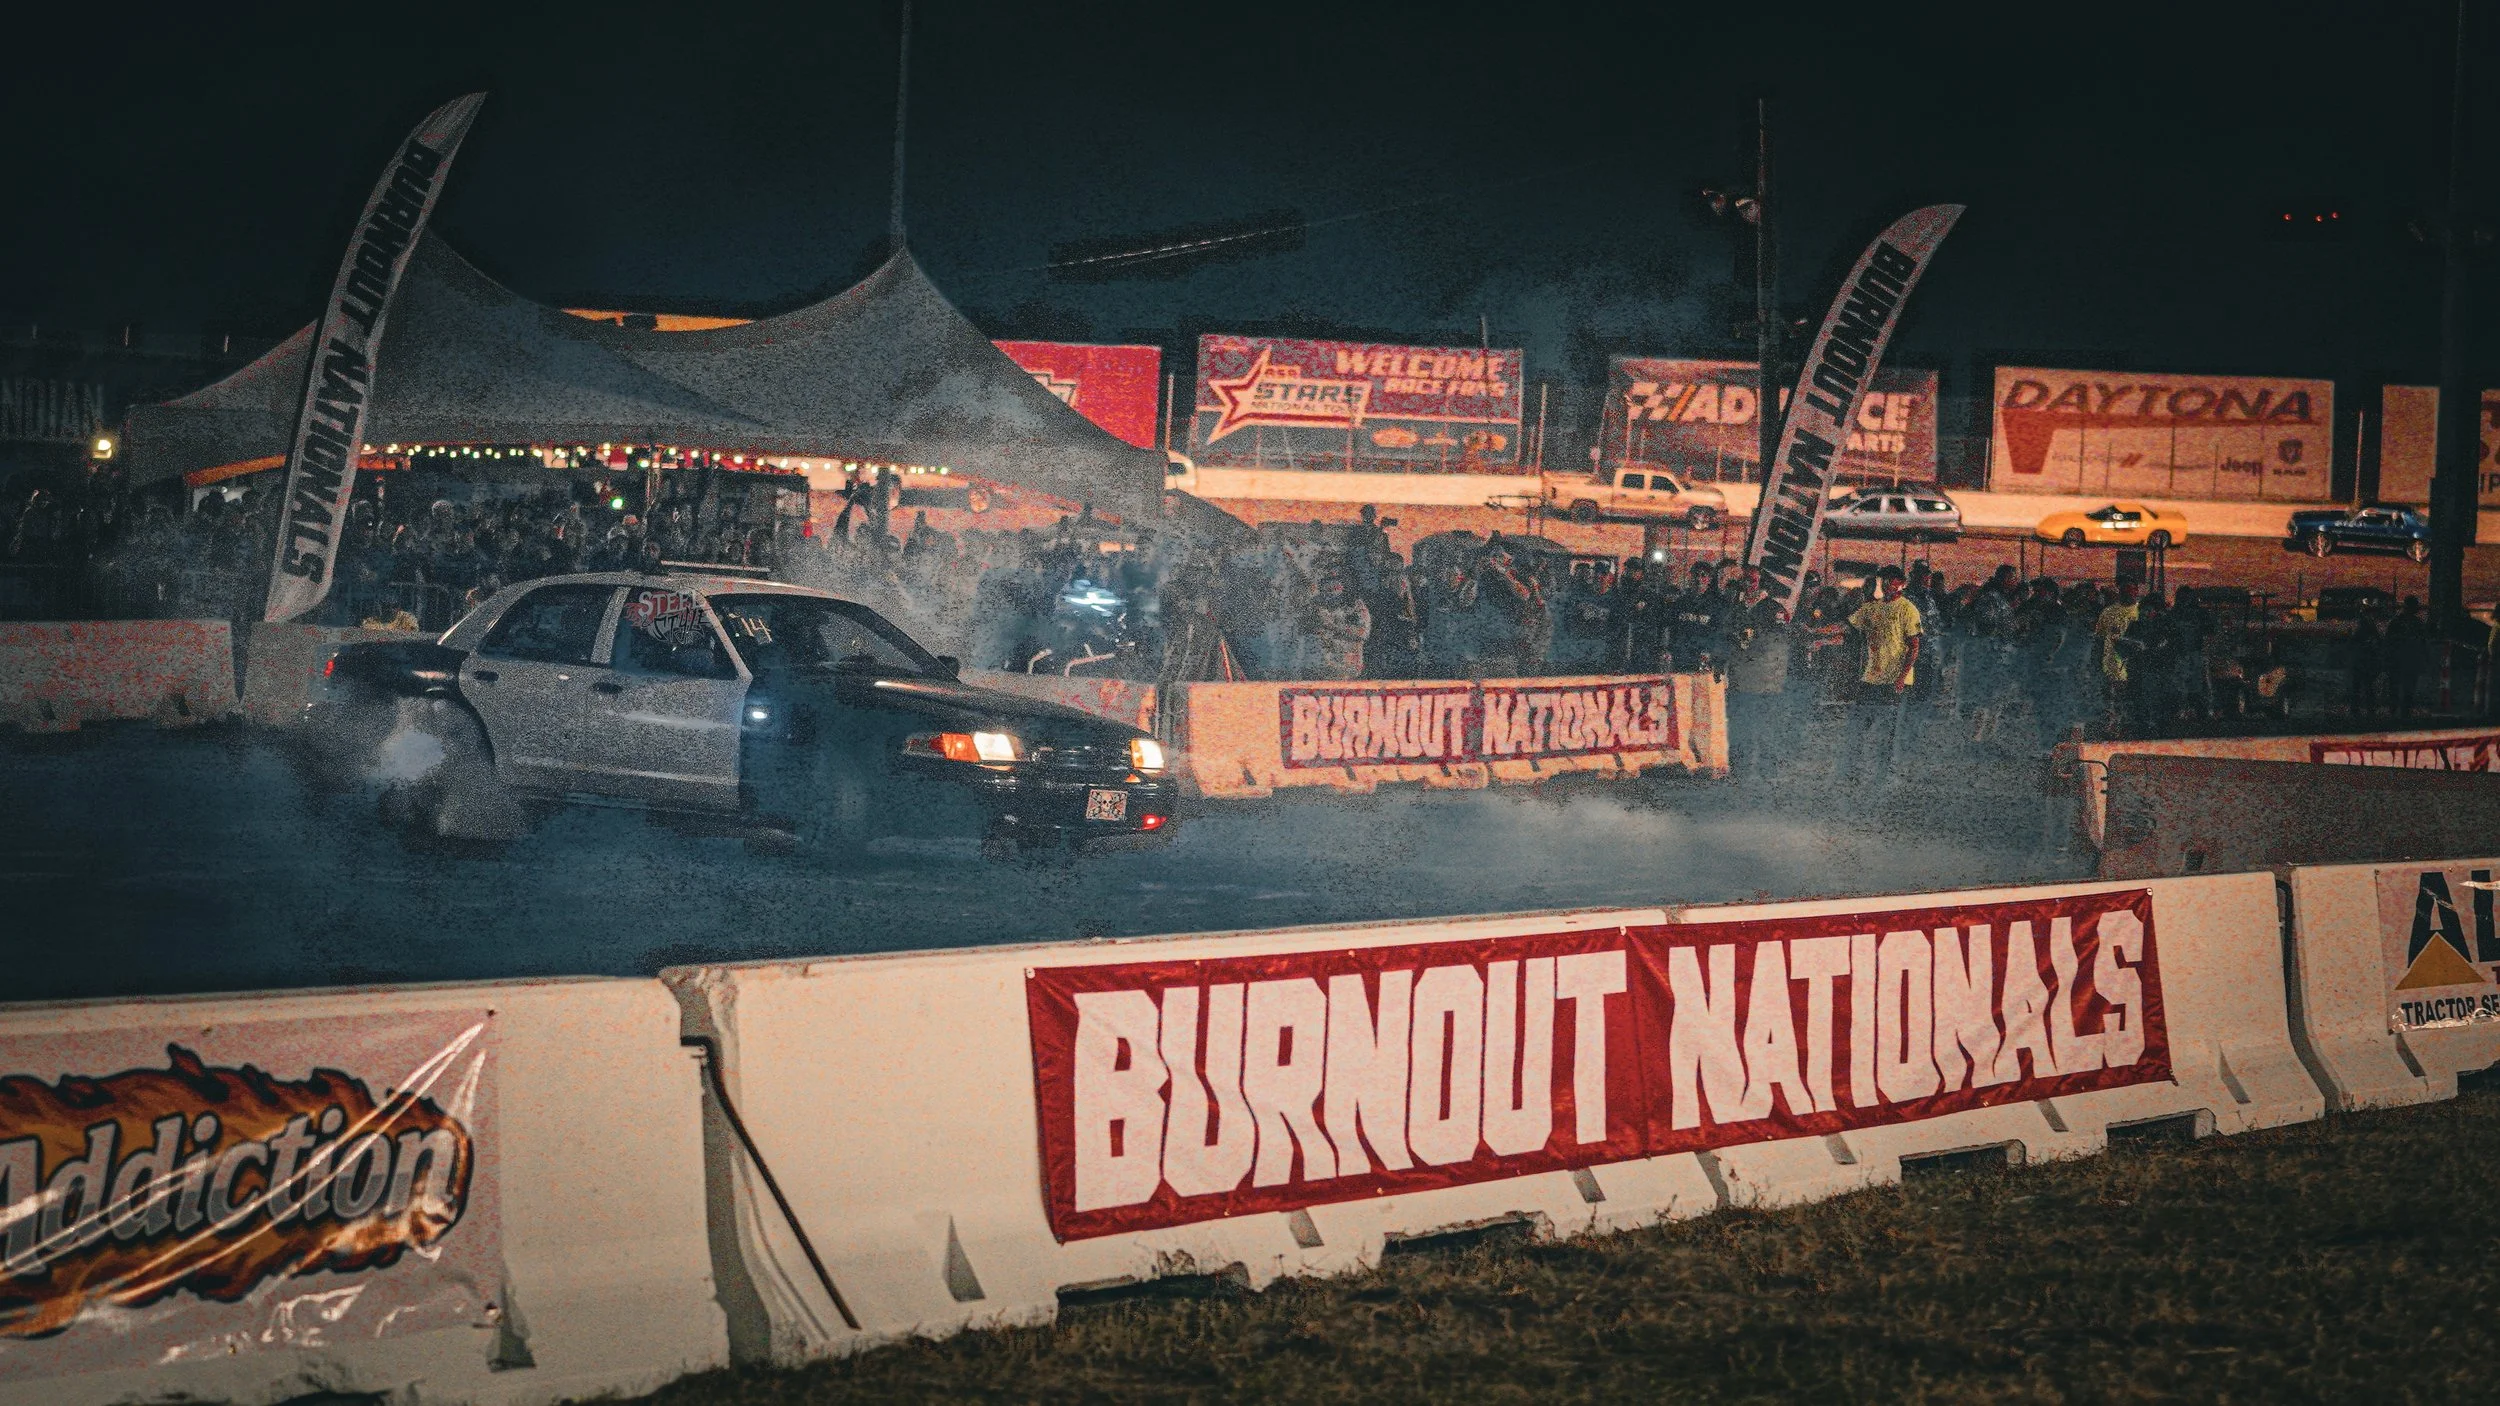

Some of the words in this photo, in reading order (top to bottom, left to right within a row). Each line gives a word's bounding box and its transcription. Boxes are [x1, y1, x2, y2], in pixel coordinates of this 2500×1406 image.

[340, 137, 444, 338] BURNOUT
[1804, 239, 1918, 429] BURNOUT
[1335, 348, 1506, 381] WELCOME
[1253, 381, 1366, 403] STARS
[1383, 376, 1445, 395] RACE
[2003, 379, 2312, 421] DAYTONA
[1845, 430, 1906, 452] ARTS
[282, 337, 368, 585] NATIONALS
[2219, 455, 2263, 477] Jeep
[638, 589, 708, 618] STEEL
[1291, 692, 1474, 762] BURNOUT
[1481, 684, 1670, 755] NATIONALS
[2401, 996, 2476, 1026] TRACTOR
[1073, 949, 1627, 1212] BURNOUT
[1667, 909, 2145, 1132] NATIONALS
